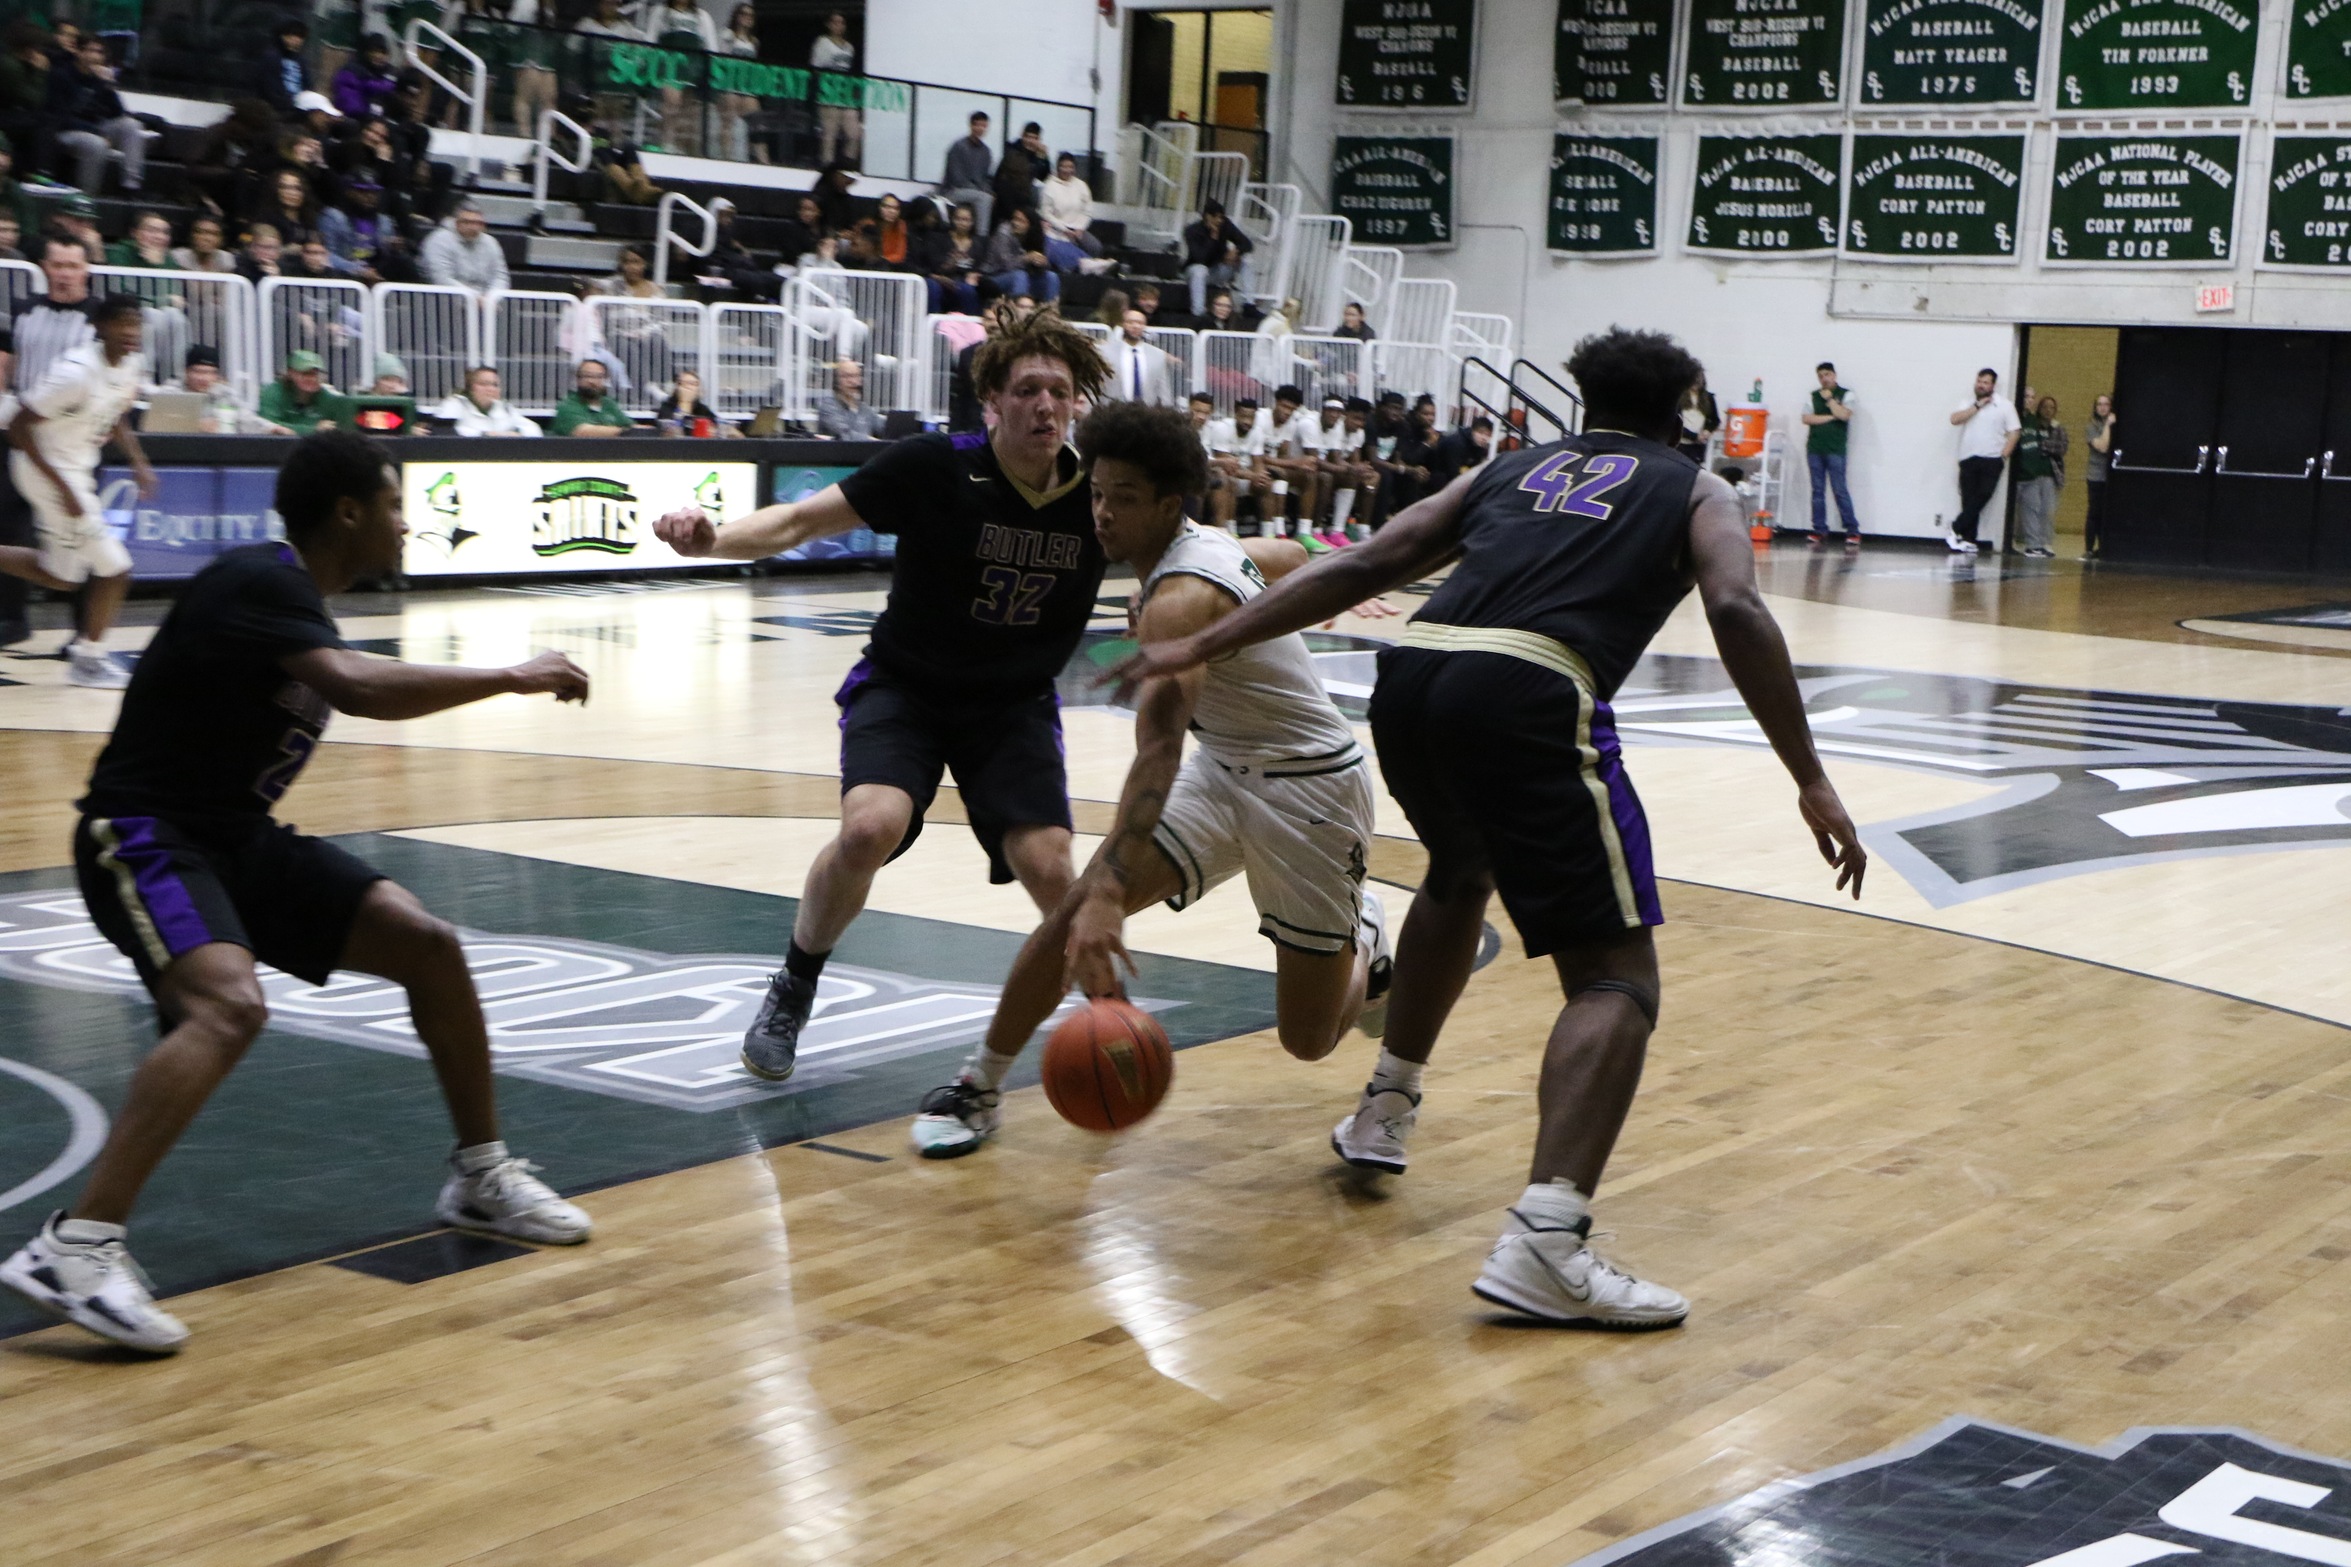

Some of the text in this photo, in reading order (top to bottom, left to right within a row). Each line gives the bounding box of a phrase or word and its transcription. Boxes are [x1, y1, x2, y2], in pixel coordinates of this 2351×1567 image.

[1869, 0, 1923, 36] NJCAA
[2069, 0, 2121, 38] NJCAA
[1911, 20, 1994, 37] BASEBALL
[2120, 19, 2202, 37] BASEBALL
[1722, 56, 1802, 72] BASEBALL
[1894, 48, 2008, 65] MATT YEAGER
[2101, 47, 2209, 64] TIM FORKNER
[710, 56, 812, 101] STUDENT
[816, 71, 908, 112] SECTION
[1732, 82, 1790, 100] 2002
[1921, 76, 1977, 94] 1975
[2130, 75, 2179, 94] 1993
[1854, 145, 2018, 188] NJCAA ALL-AMERICAN
[2056, 144, 2233, 190] NJCAA NATIONAL PLAYER
[2274, 153, 2328, 192] NJCAA
[1894, 174, 1975, 190] BASEBALL
[2099, 169, 2190, 186] OF THE YEAR
[2319, 172, 2339, 187] OF
[1879, 198, 1986, 215] CORY PATTON
[2103, 192, 2181, 208] BASEBALL
[2085, 217, 2193, 233] CORY PATTON
[2304, 221, 2349, 237] CORY
[1901, 231, 1960, 249] 2002
[2107, 240, 2169, 257] 2002
[2202, 287, 2228, 308] EXIT
[1517, 450, 1639, 521] 42
[532, 495, 638, 545] SAINTS
[975, 522, 1082, 569] BUTLER
[970, 565, 1057, 626] 32
